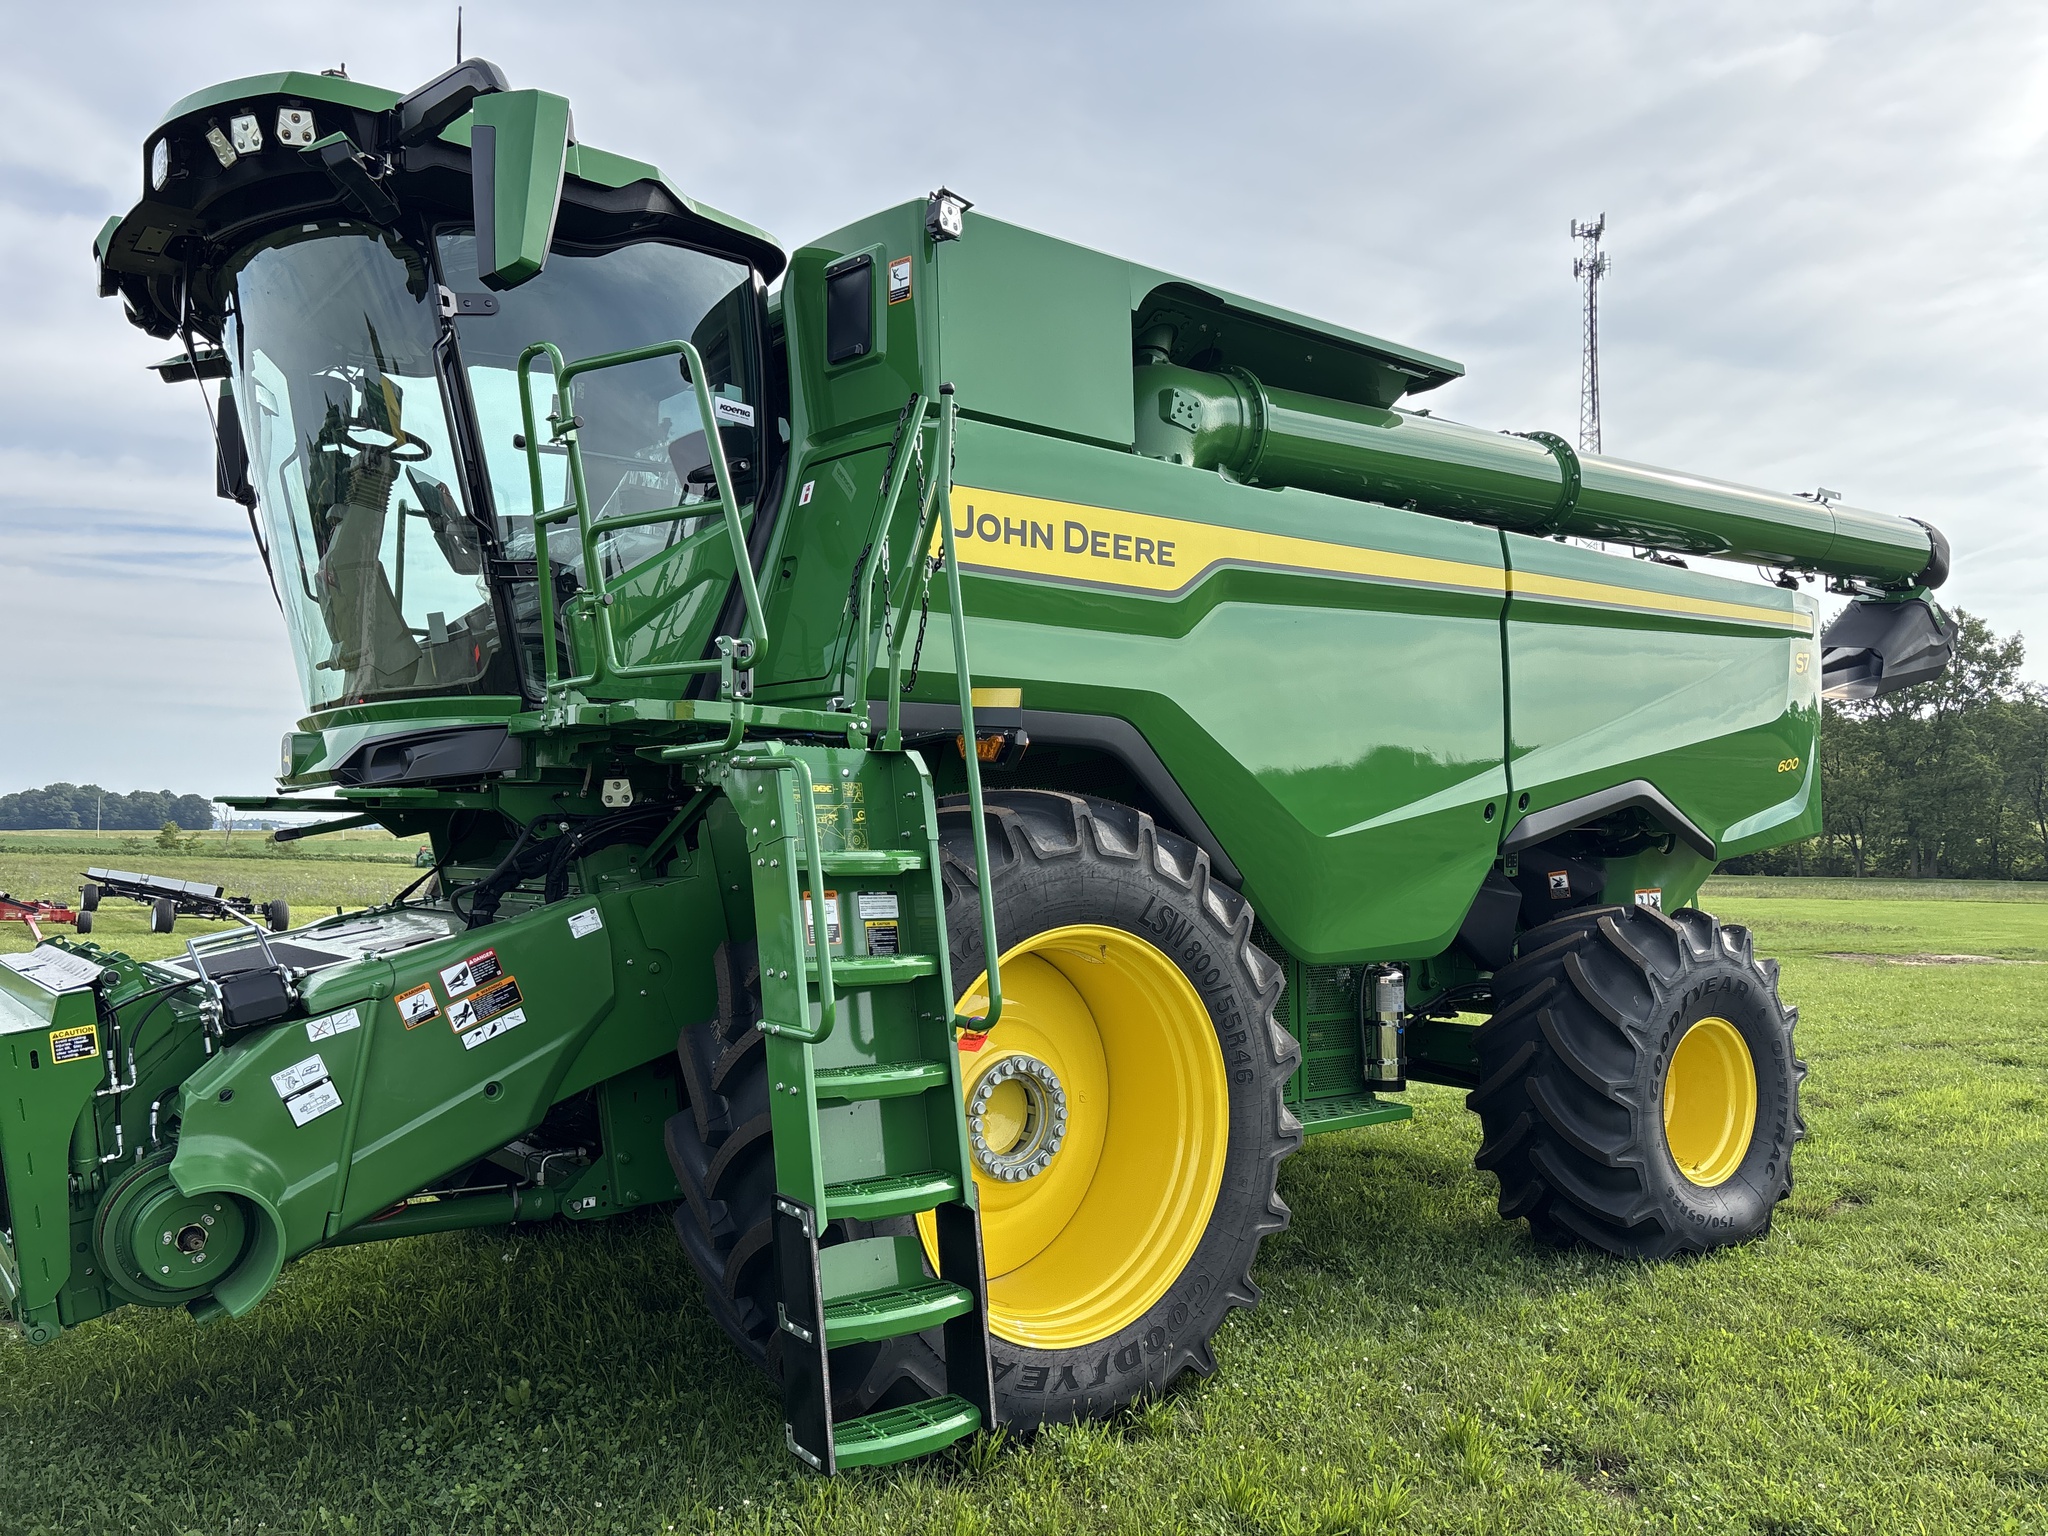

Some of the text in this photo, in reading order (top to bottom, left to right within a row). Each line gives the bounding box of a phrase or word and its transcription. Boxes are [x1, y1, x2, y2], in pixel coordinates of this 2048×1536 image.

[954, 504, 1176, 568] JOHN DEERE
[1795, 652, 1810, 674] S7
[1777, 756, 1799, 773] 600
[472, 950, 494, 963] DANGER
[1135, 895, 1254, 1085] LSW 800/55R46
[58, 1026, 94, 1038] CAUTION
[1650, 975, 1749, 1104] GOODYEAR
[1765, 1038, 1788, 1181] OPTITRAC
[1666, 1186, 1735, 1230] 750/65R26
[991, 1273, 1210, 1393] GOODYEA
